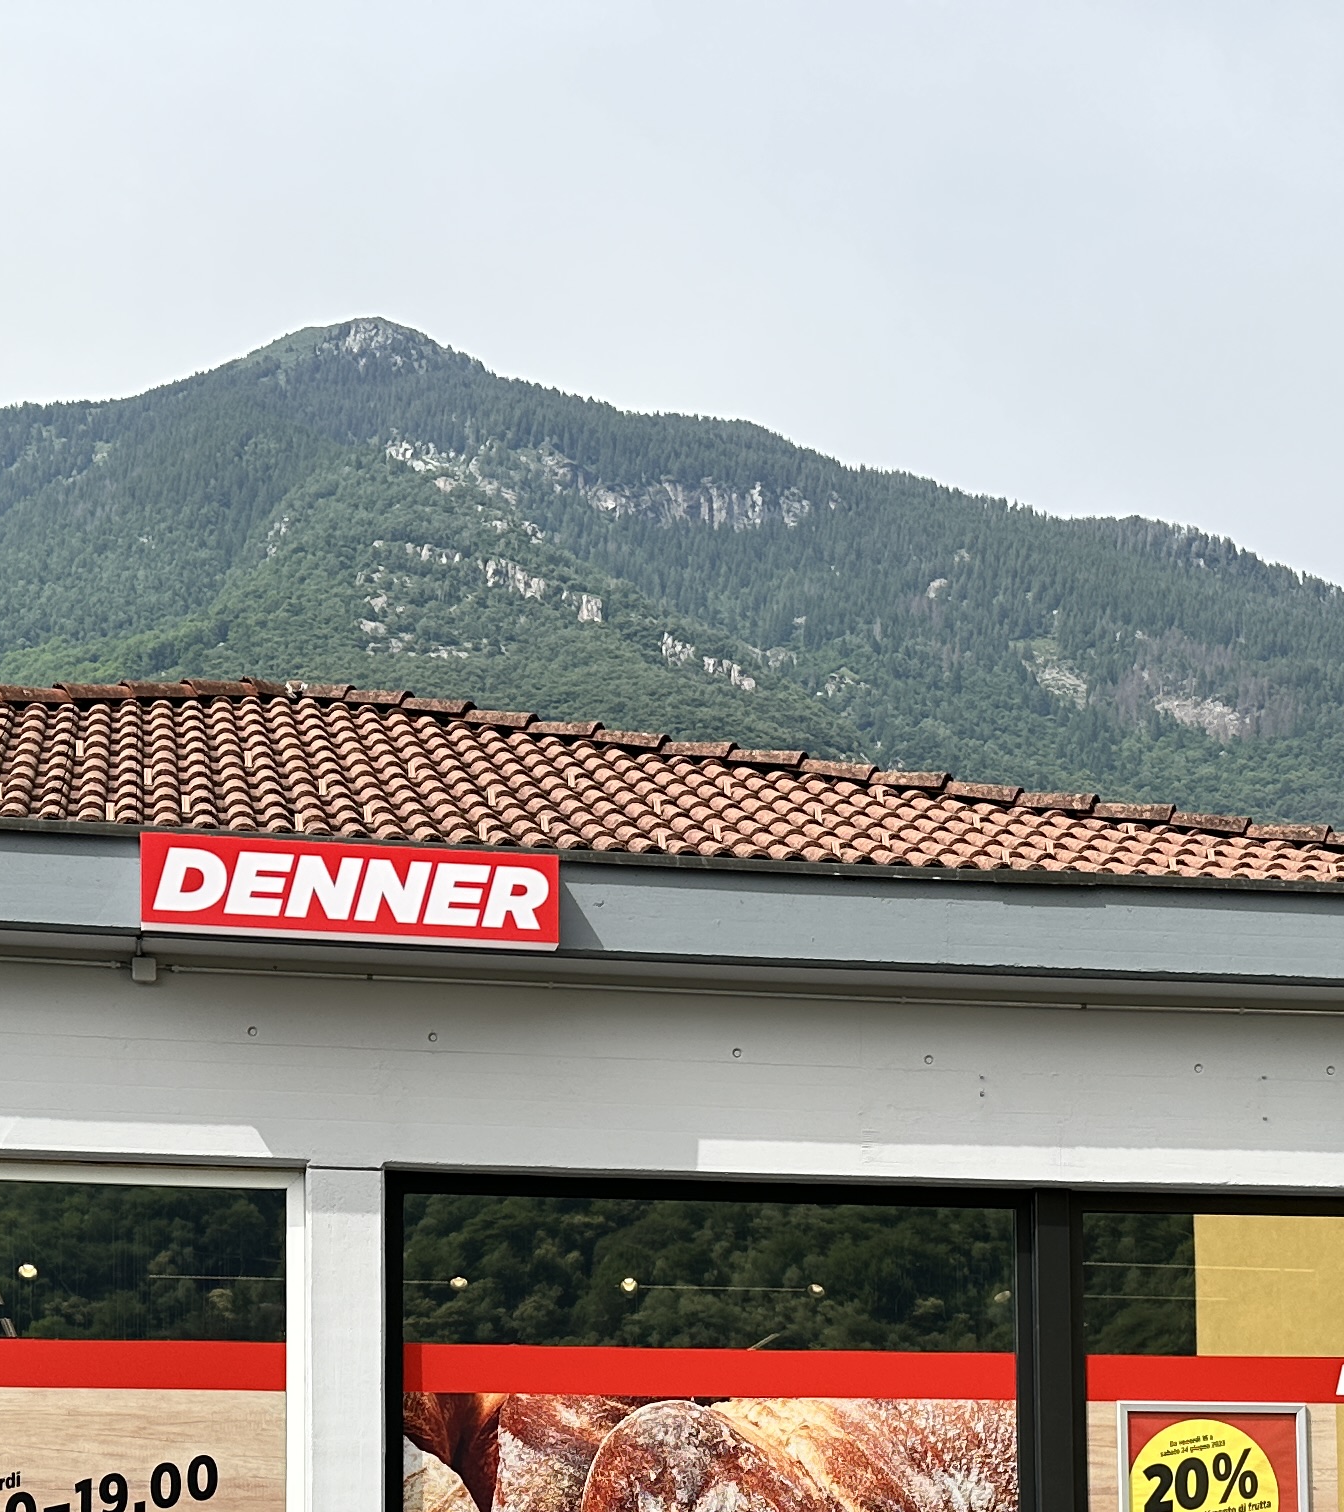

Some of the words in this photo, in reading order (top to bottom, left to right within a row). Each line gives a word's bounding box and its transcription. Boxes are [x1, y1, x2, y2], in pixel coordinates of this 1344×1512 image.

[152, 846, 550, 930] DENNER
[1238, 1503, 1247, 1512] di
[1248, 1500, 1272, 1511] frutta
